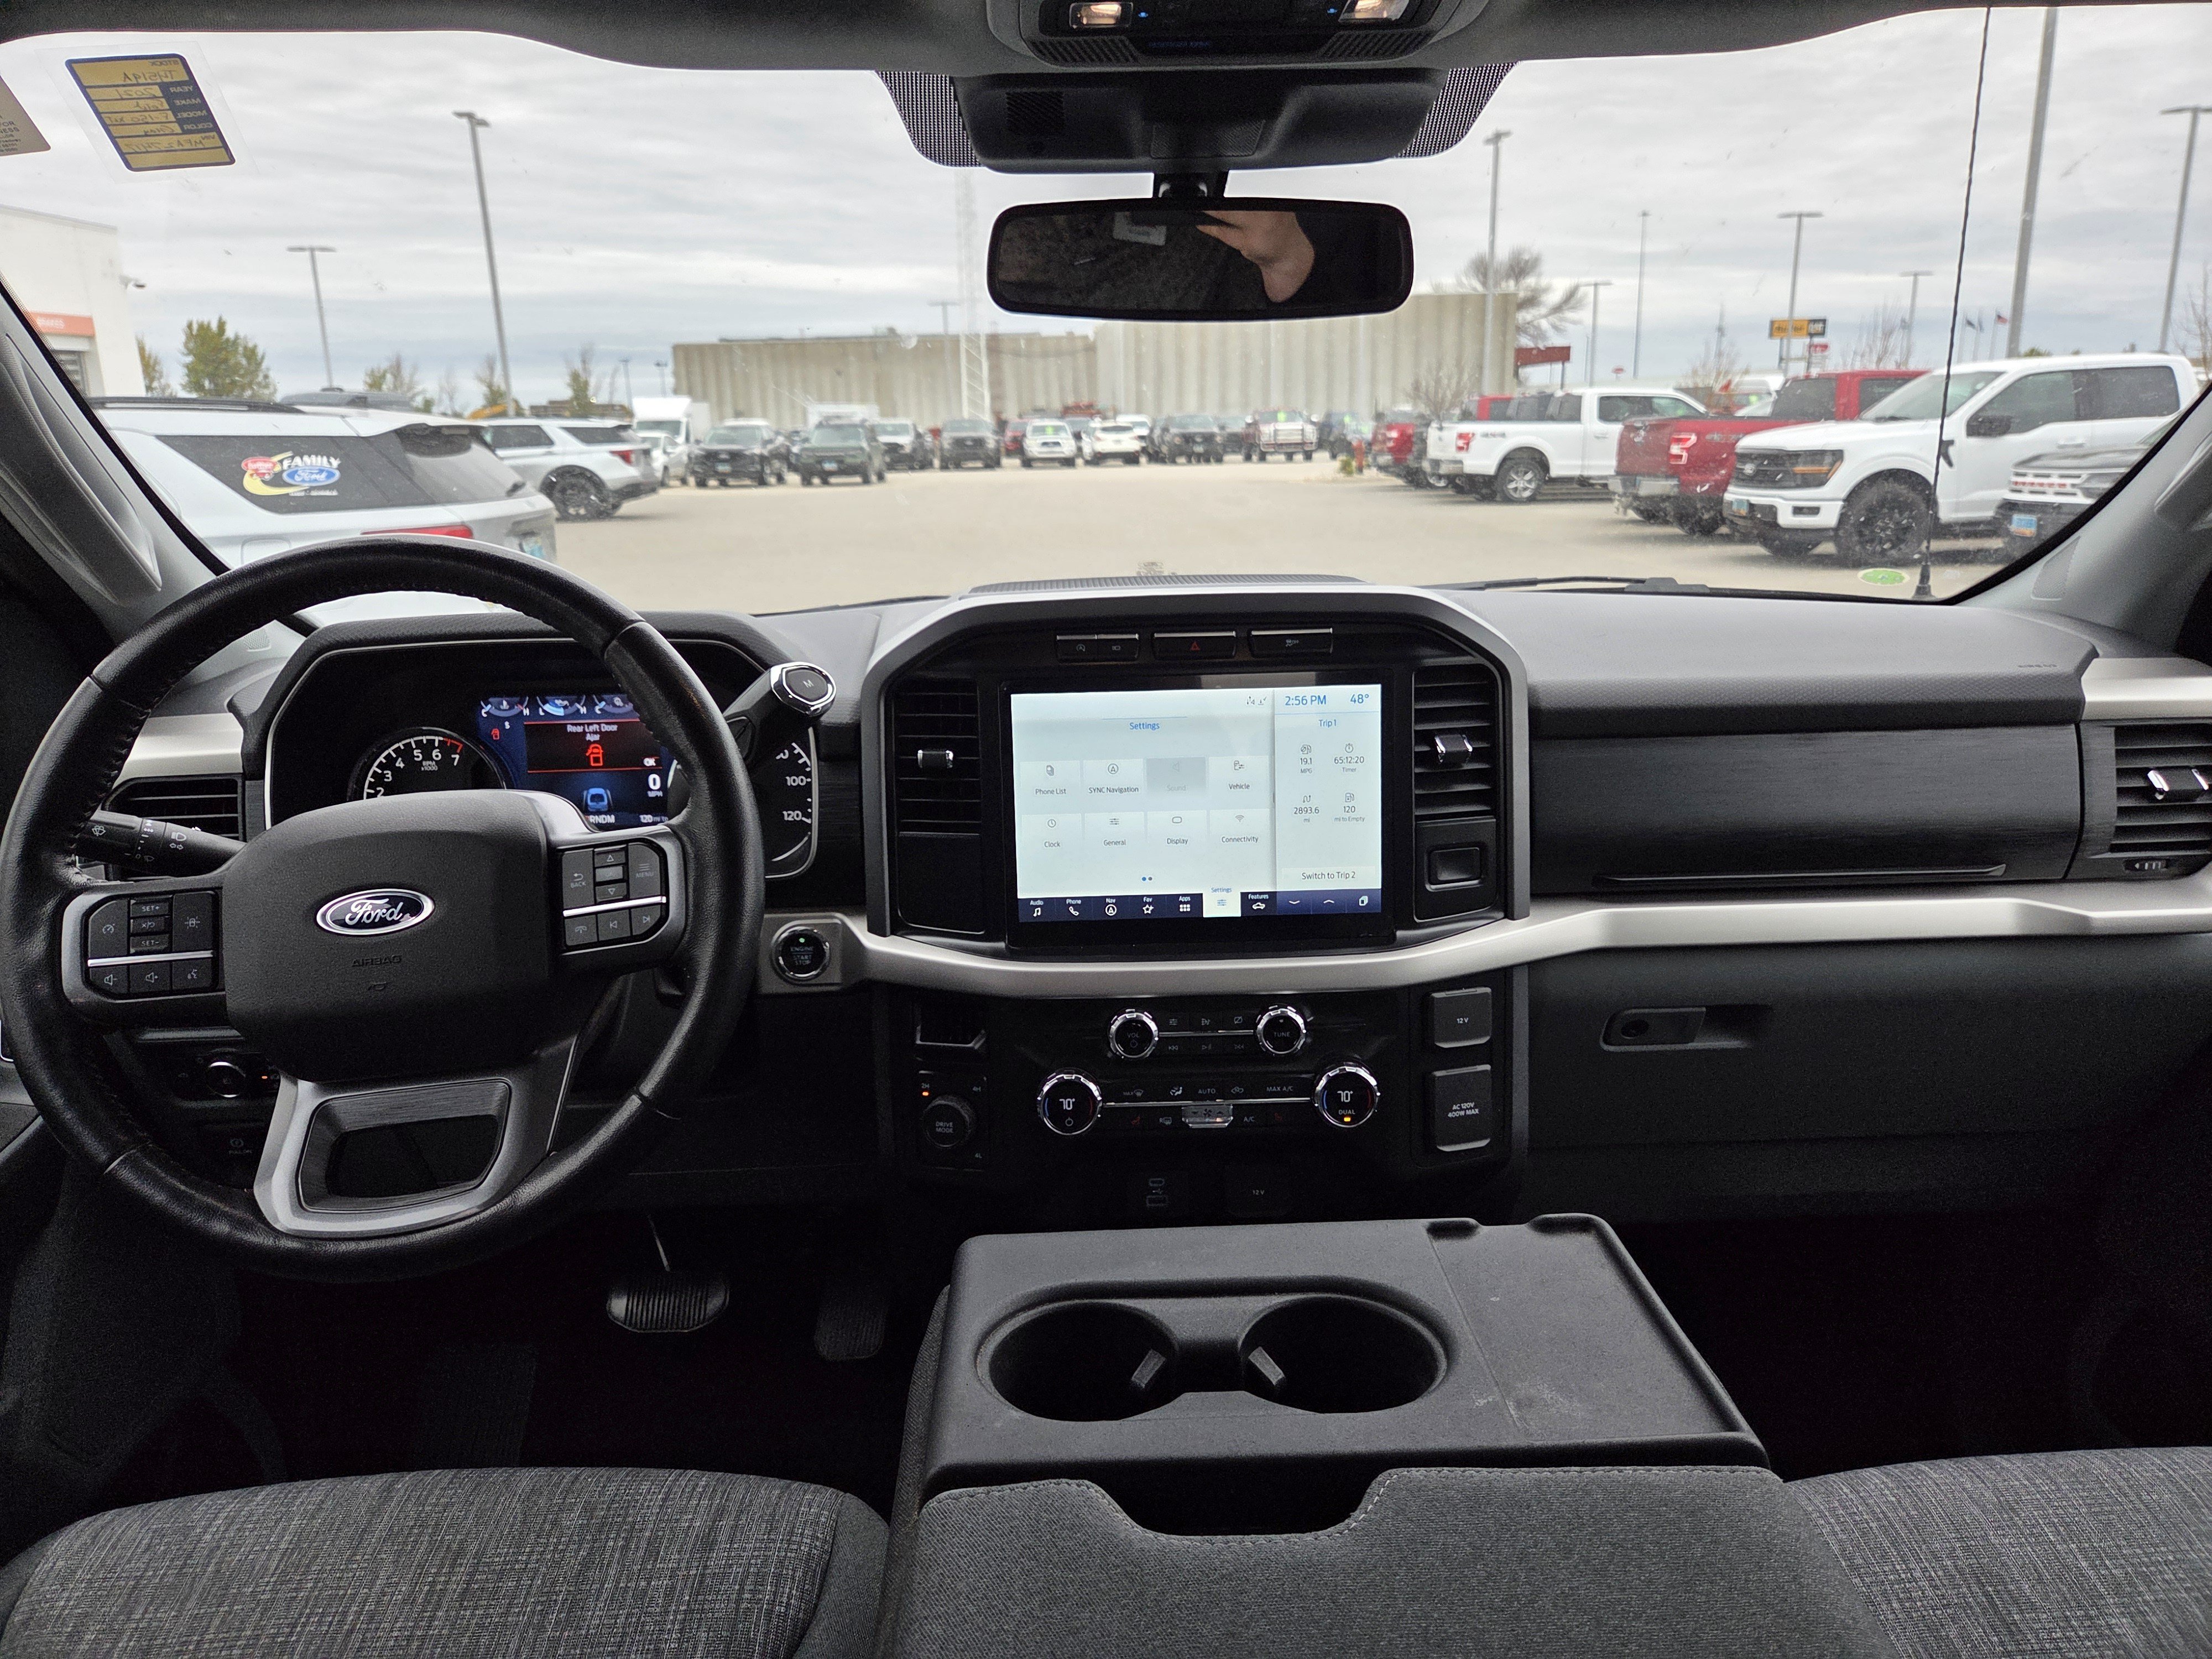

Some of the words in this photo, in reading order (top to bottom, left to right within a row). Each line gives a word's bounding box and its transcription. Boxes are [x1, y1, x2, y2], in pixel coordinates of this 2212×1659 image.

[283, 455, 341, 470] FAMILY
[294, 468, 328, 482] Ford
[802, 679, 814, 688] M
[1285, 695, 1308, 706] 2:56
[1311, 695, 1327, 705] PM
[1350, 693, 1370, 705] 48°
[601, 723, 618, 732] Door
[1129, 722, 1160, 731] Settings
[1319, 719, 1332, 728] Trip
[586, 733, 601, 742] Ajar
[414, 749, 422, 761] 5
[432, 749, 441, 760] 6
[451, 754, 460, 766] 7
[1334, 756, 1364, 764] 65:12:20
[395, 757, 405, 769] 4
[383, 770, 392, 781] 3
[785, 775, 807, 786] 100
[648, 774, 661, 790] 0
[376, 787, 384, 797] 2
[1107, 786, 1139, 795] Navigation
[640, 815, 653, 823] 120
[782, 810, 802, 821] 120
[1166, 837, 1188, 846] Display
[1302, 872, 1325, 880] Switch
[1337, 872, 1350, 880] Trip
[345, 898, 404, 925] Ford
[352, 954, 403, 967] AIRBAG
[1337, 1091, 1353, 1103] 70°
[1059, 1098, 1076, 1110] 70°
